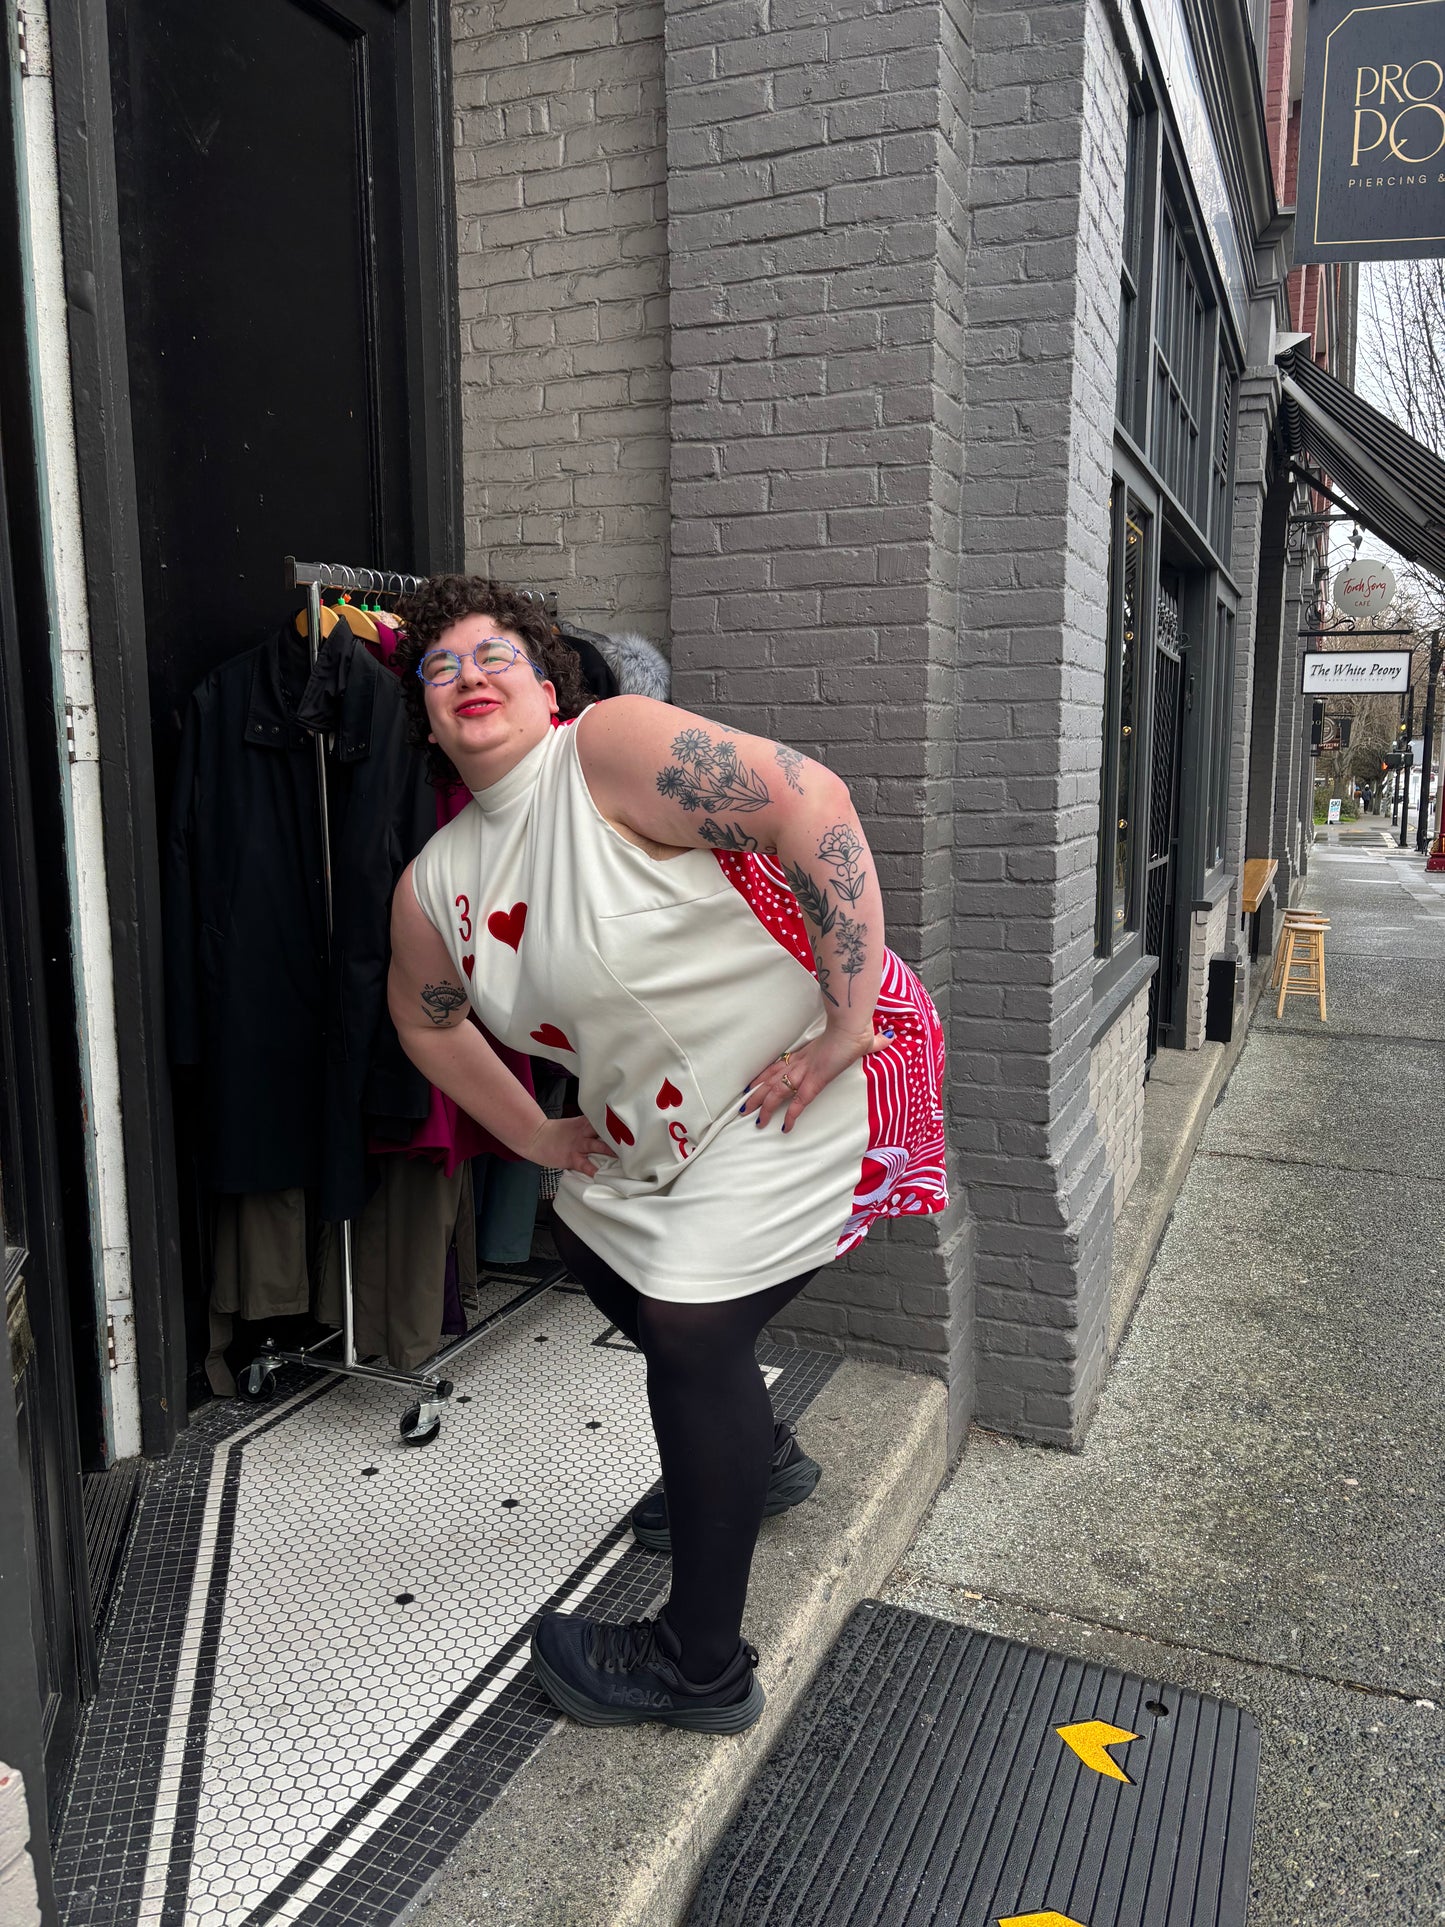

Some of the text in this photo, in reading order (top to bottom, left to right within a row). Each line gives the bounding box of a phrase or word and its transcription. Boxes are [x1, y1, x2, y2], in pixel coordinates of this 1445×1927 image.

[1348, 173, 1445, 188] PIERCING &
[1343, 575, 1387, 599] Torch Song
[1310, 663, 1402, 679] The White Peony
[455, 894, 473, 942] 3
[608, 1684, 674, 1709] HOKA
